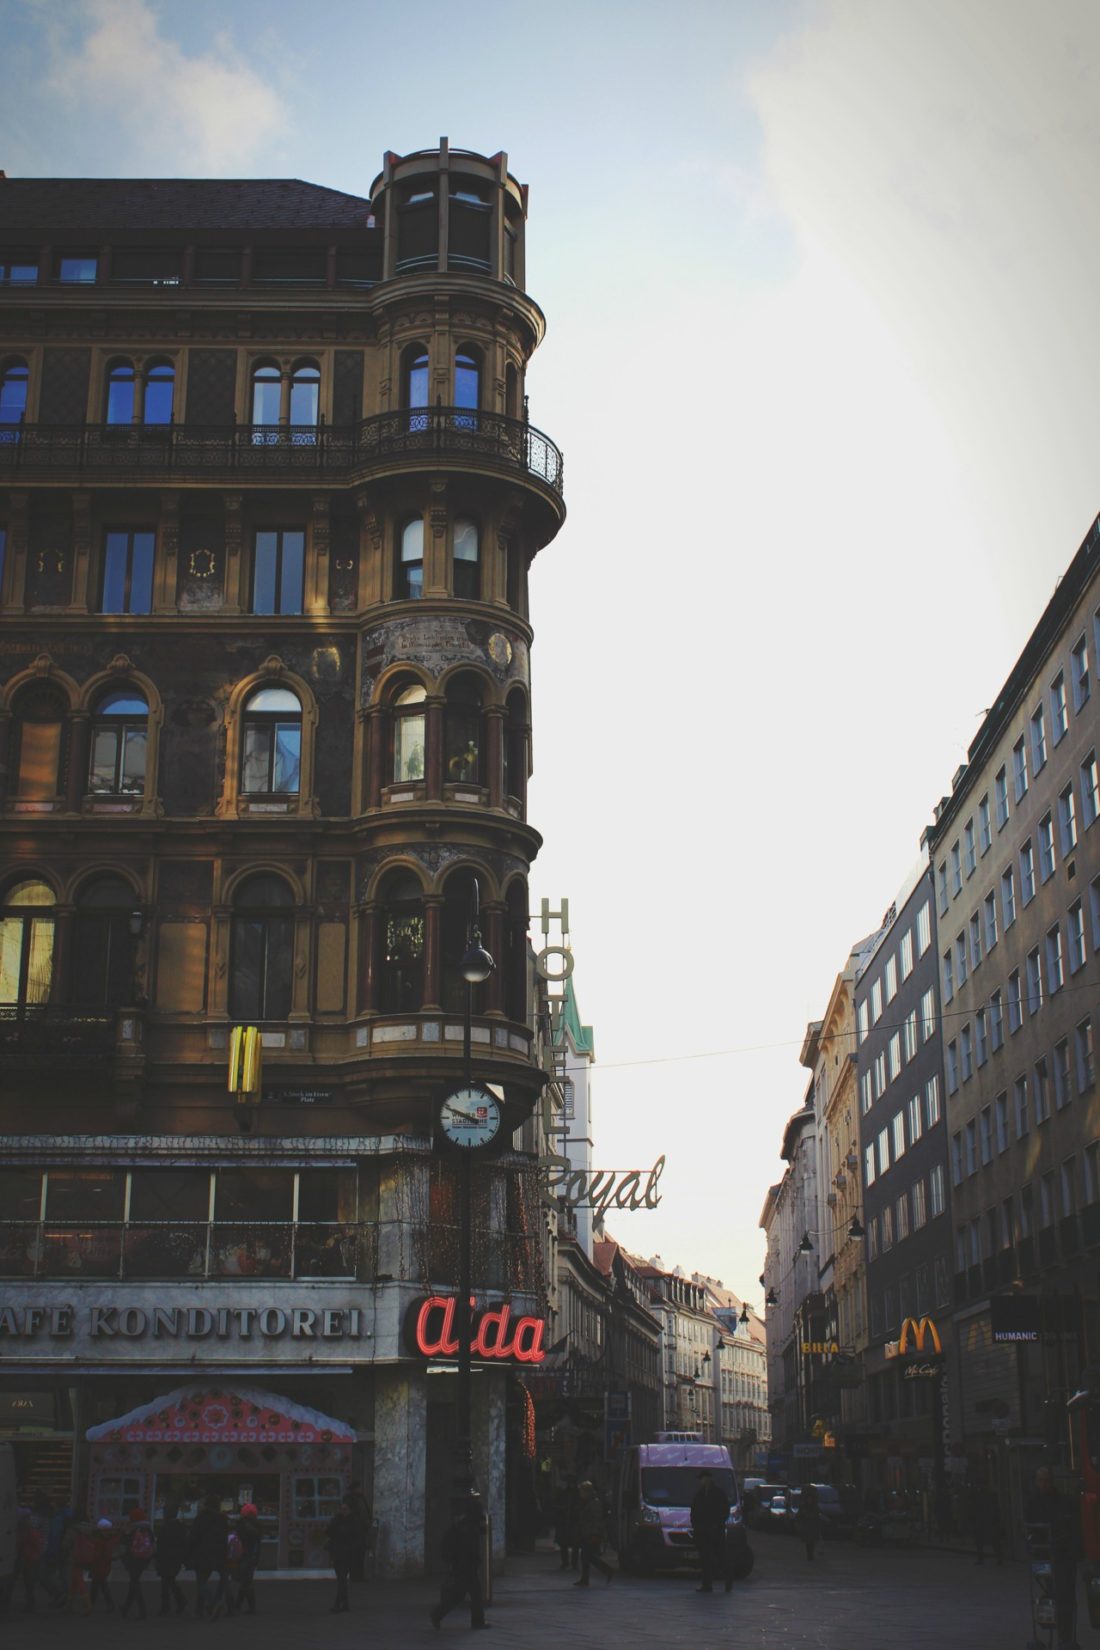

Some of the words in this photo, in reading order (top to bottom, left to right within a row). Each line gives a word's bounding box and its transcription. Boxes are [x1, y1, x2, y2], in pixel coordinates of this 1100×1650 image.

[537, 898, 575, 1134] HOTEL
[538, 1154, 665, 1233] Royal
[89, 1307, 362, 1338] KONDITOREI
[994, 1331, 1038, 1341] HUMANIC
[801, 1342, 840, 1354] BILLA
